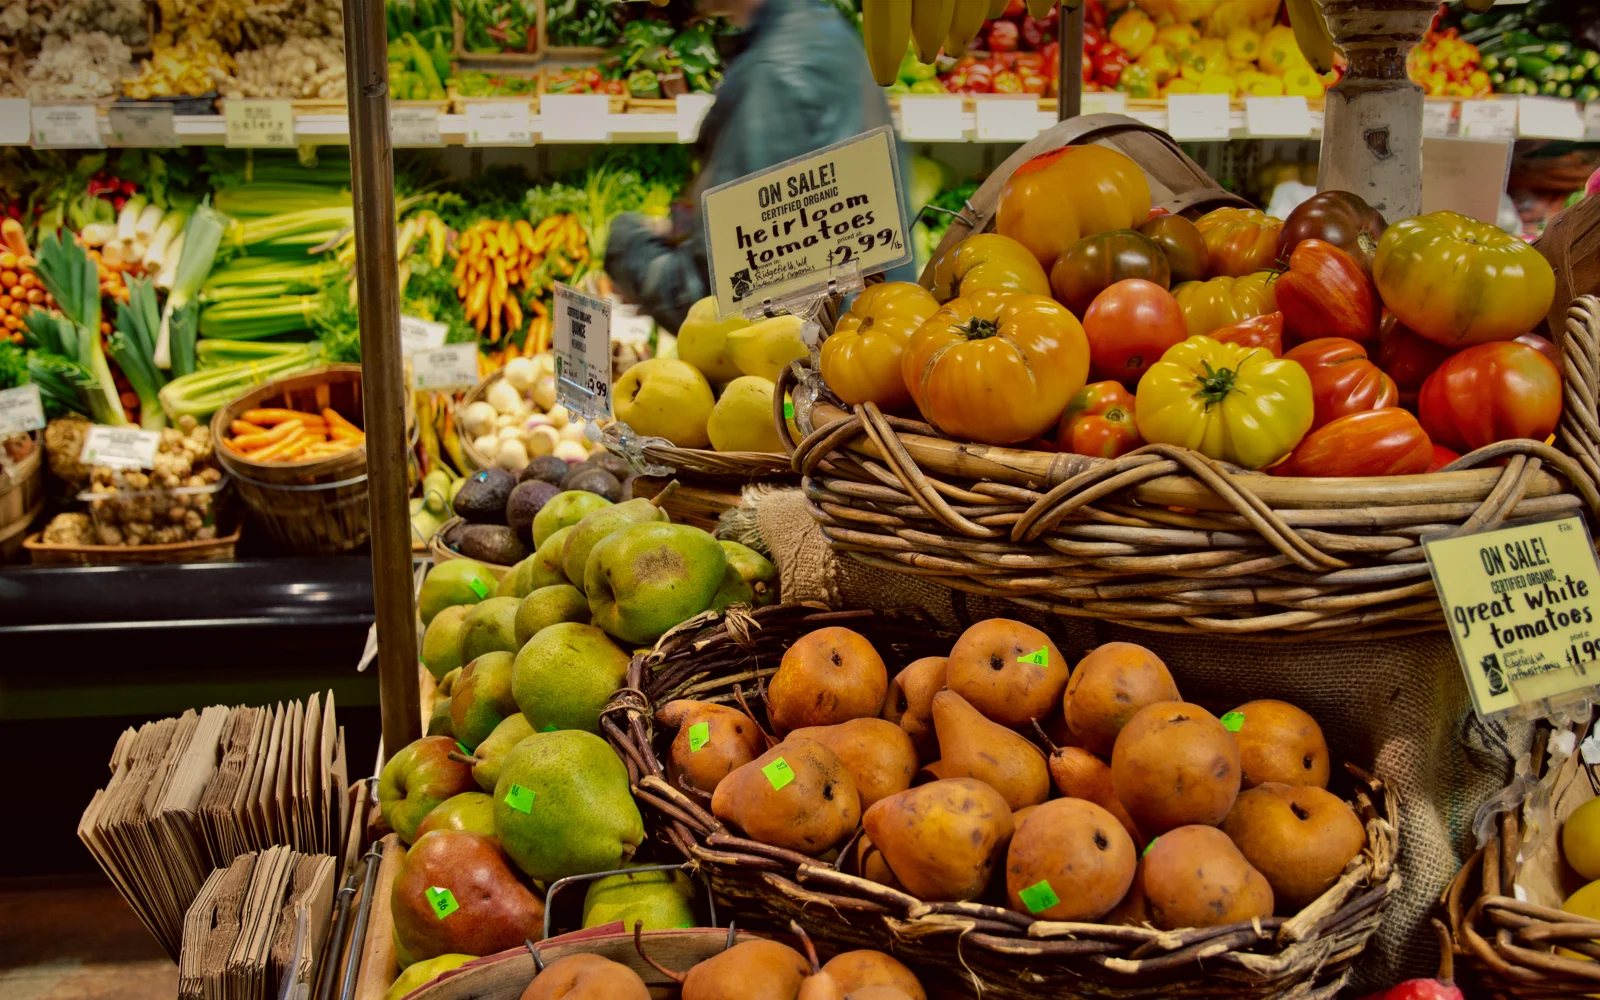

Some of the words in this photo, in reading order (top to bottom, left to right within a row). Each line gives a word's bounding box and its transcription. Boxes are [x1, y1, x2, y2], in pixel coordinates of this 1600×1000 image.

[758, 181, 782, 208] ON
[787, 162, 836, 198] SALE!
[761, 200, 802, 221] CERTIFIED
[803, 186, 839, 207] ORGANIC
[736, 194, 869, 249] heirloom
[746, 211, 875, 270] tomatoes
[836, 233, 855, 244] priced
[1480, 546, 1506, 576] ON
[1504, 536, 1550, 571] SALE!
[1491, 575, 1527, 594] CERTIFIED
[1526, 568, 1557, 587] ORGANIC
[1454, 592, 1515, 638] great
[1524, 574, 1589, 610] white
[1490, 605, 1593, 649] tomatoes
